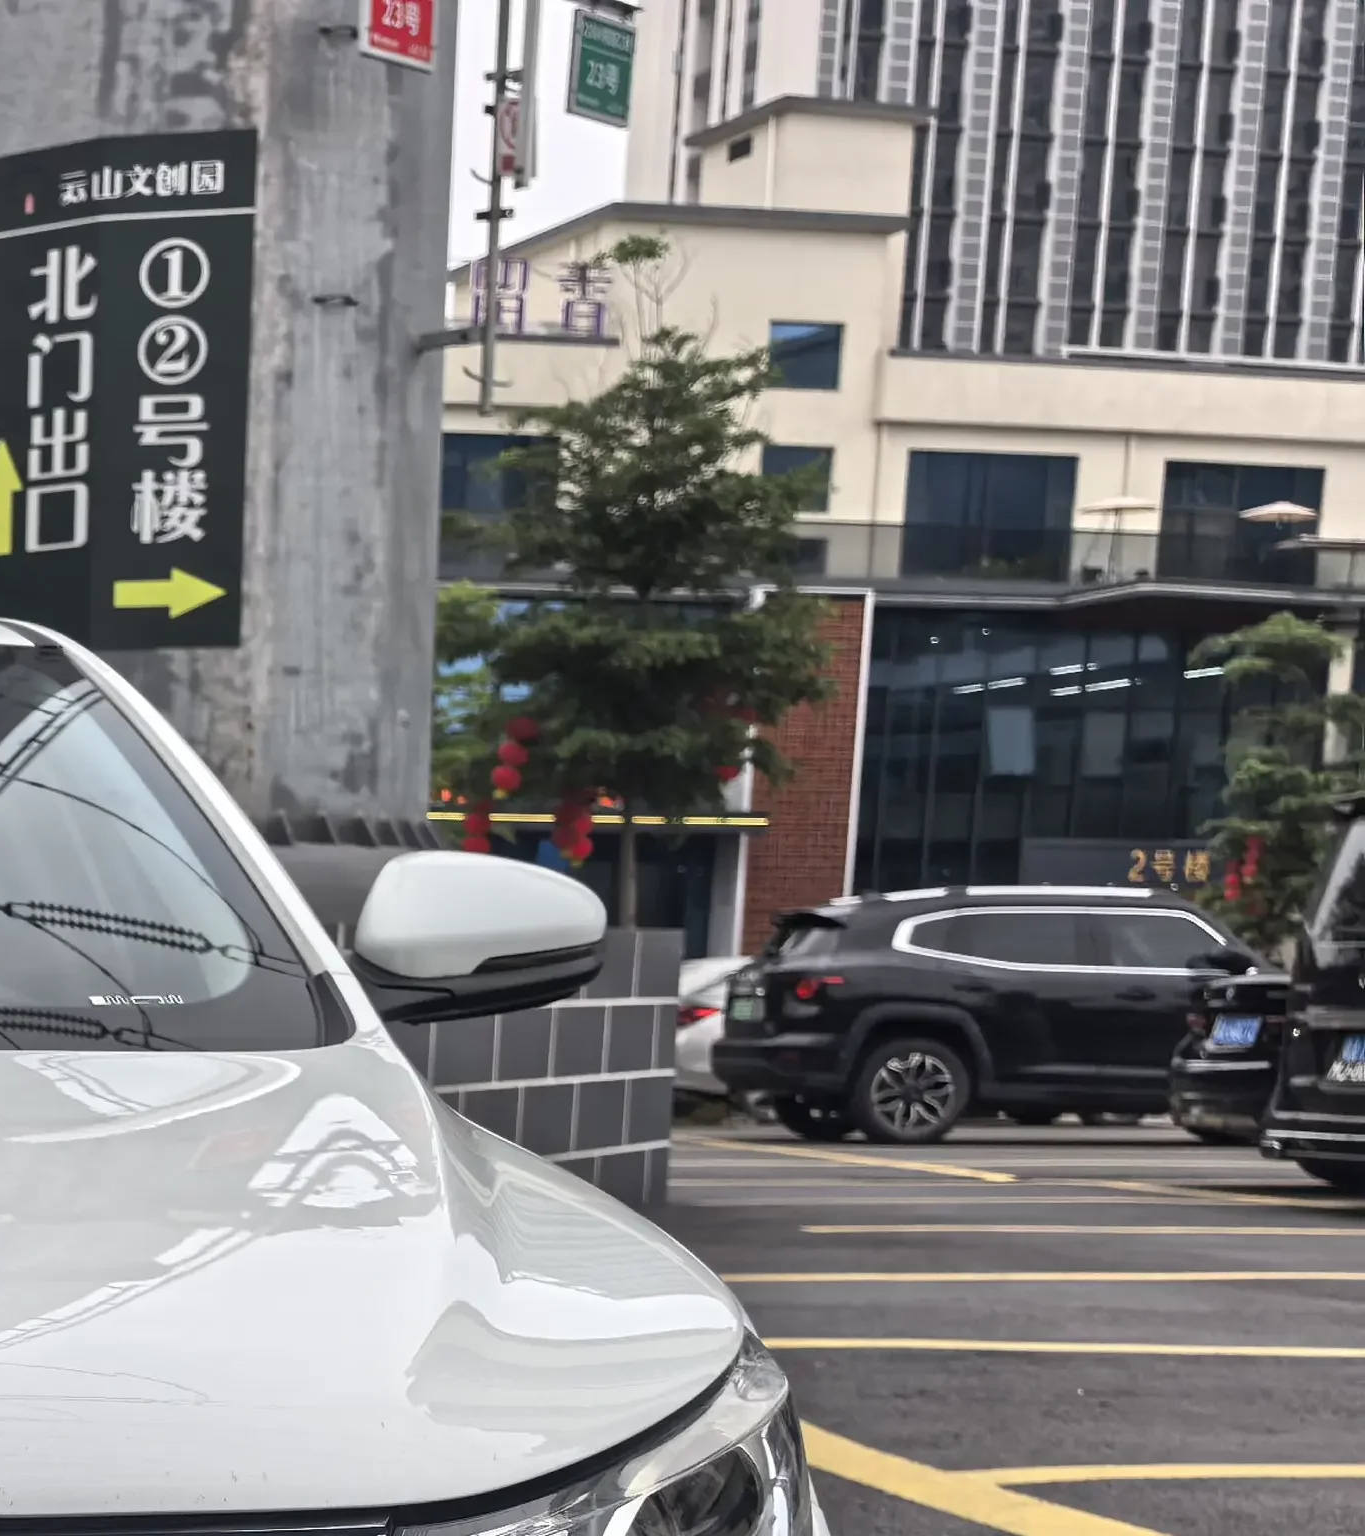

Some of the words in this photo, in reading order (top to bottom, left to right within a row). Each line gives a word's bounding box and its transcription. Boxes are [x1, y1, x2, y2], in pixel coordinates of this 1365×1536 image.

[58, 159, 225, 207] 云山文创园
[25, 245, 98, 553] 北门出口
